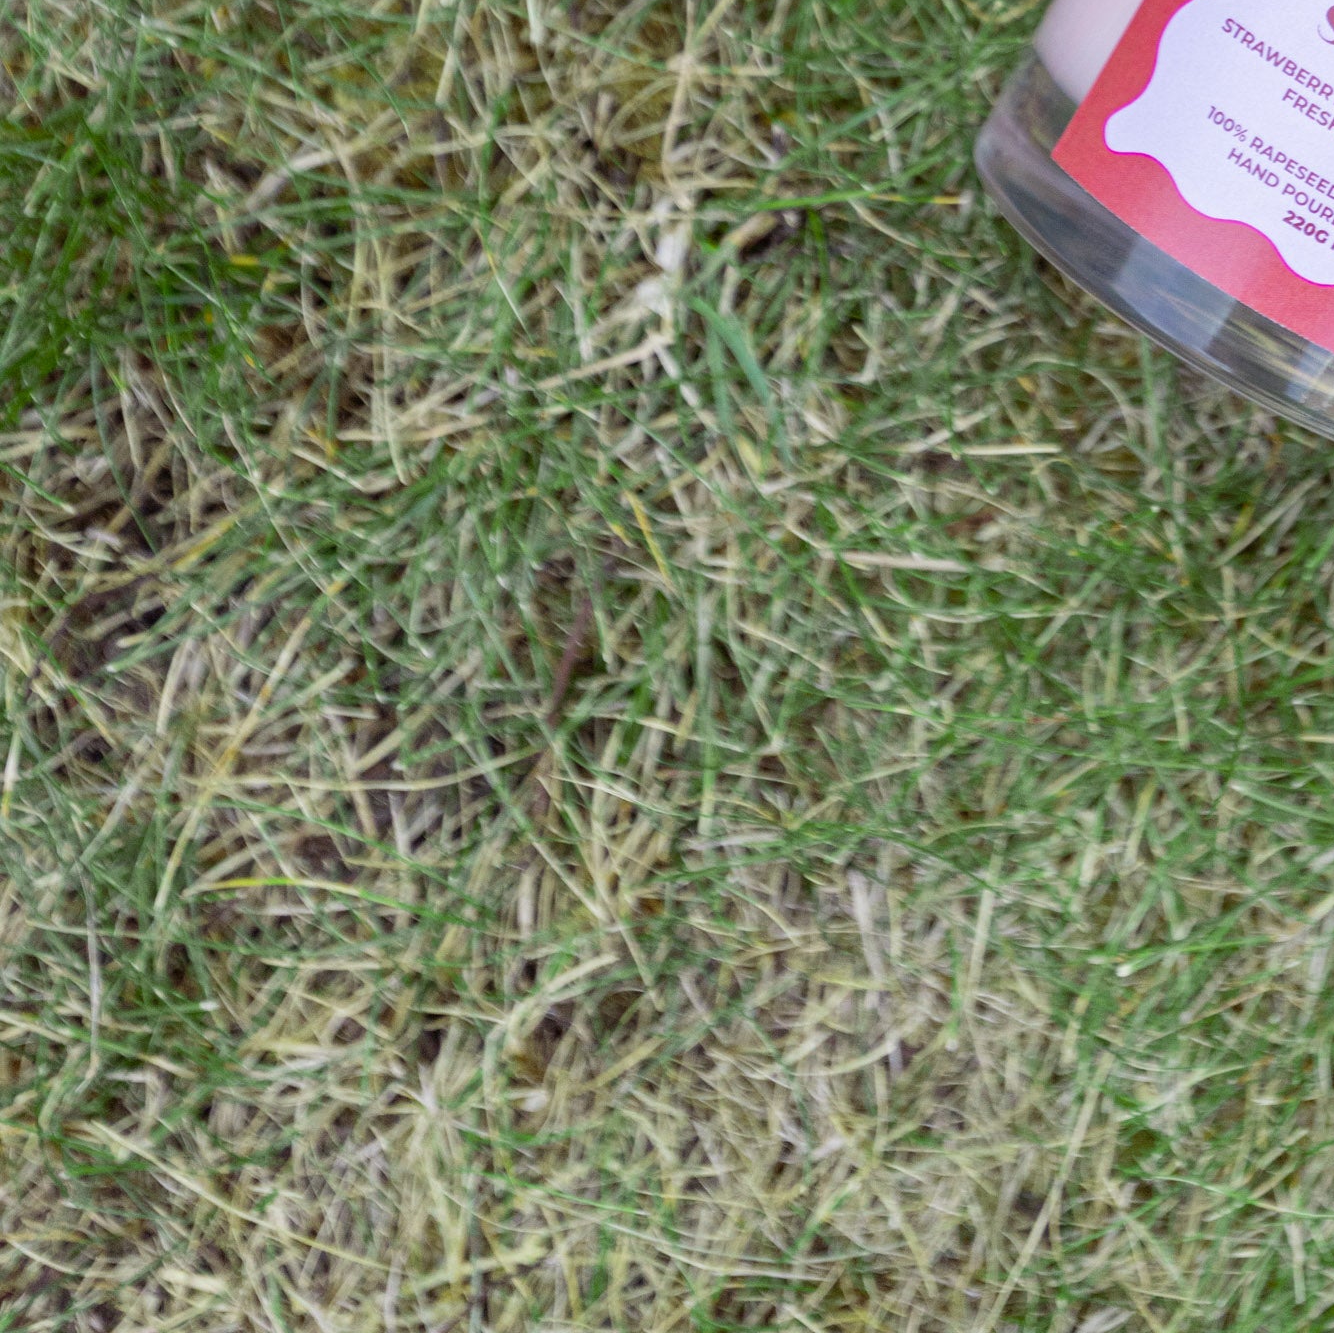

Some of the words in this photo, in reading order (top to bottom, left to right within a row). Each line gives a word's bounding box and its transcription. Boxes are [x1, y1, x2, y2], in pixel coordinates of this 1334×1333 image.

[1207, 106, 1248, 142] 100%
[1227, 148, 1279, 188] HAND
[1282, 210, 1329, 244] 220G
